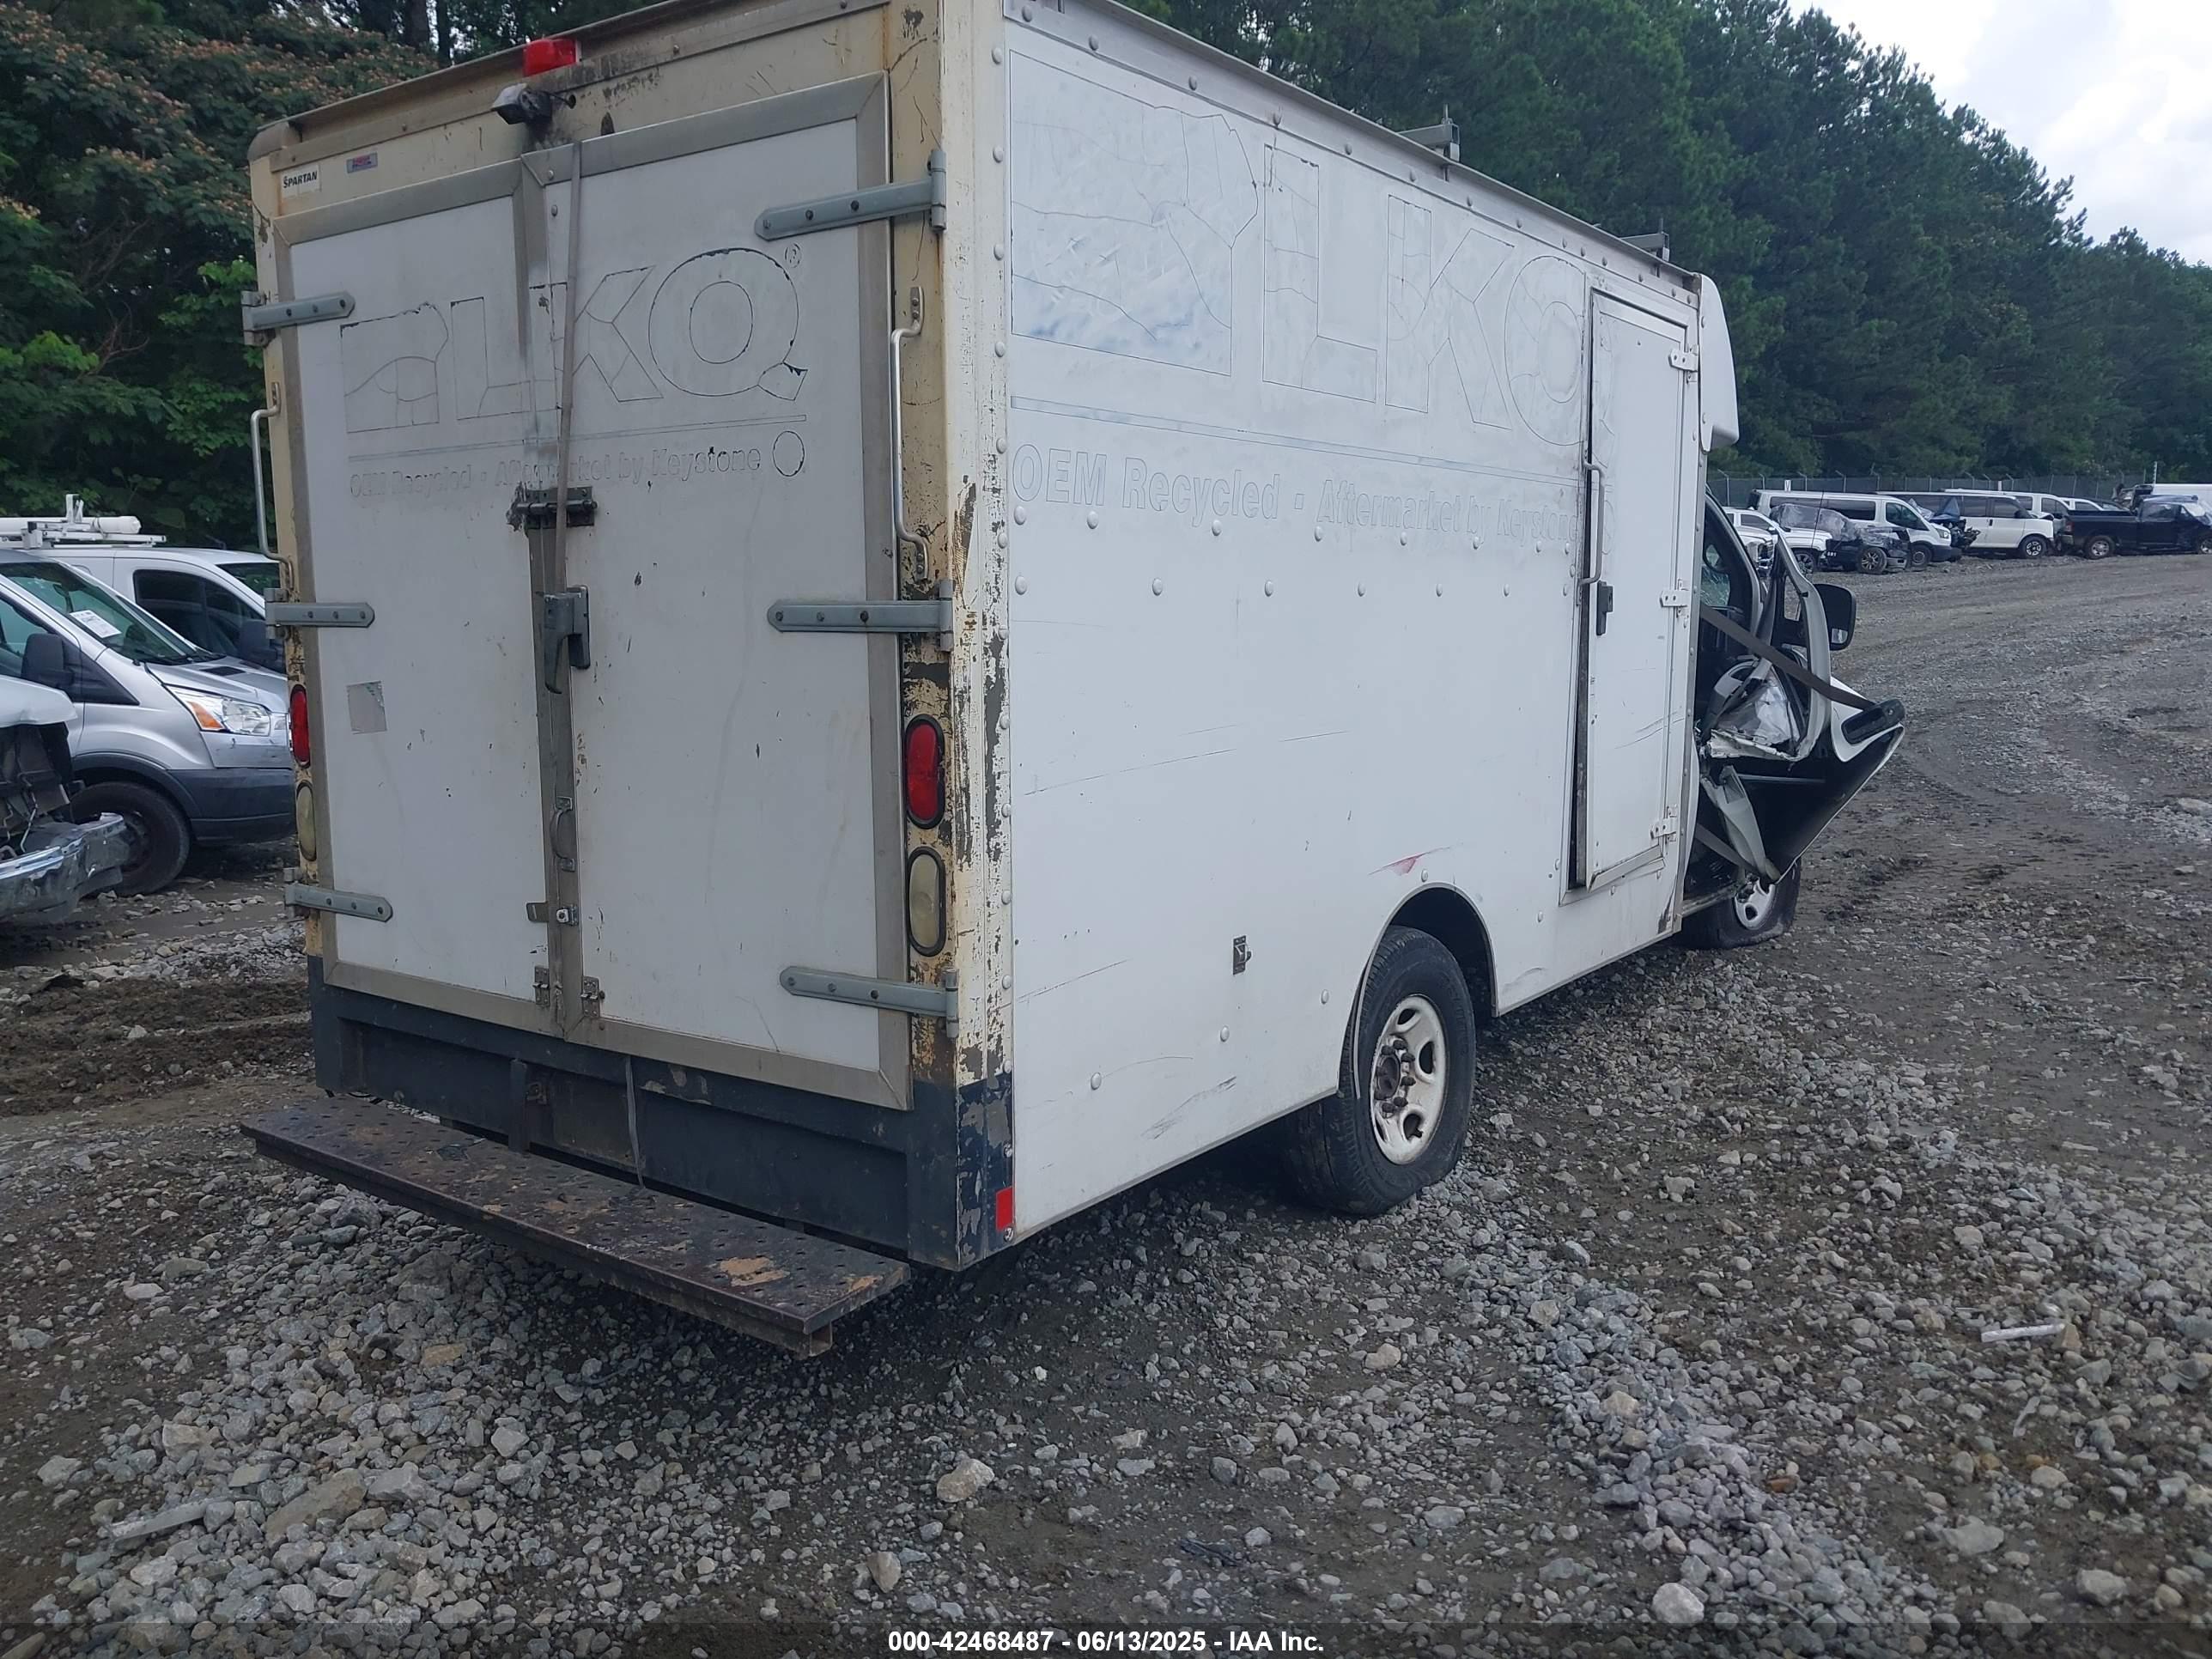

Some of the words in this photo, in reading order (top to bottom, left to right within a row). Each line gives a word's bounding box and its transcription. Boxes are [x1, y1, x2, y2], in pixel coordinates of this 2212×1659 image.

[283, 171, 318, 188] SPARTAN
[652, 447, 761, 481] Keystone
[1012, 444, 1107, 507] OEM
[1122, 457, 1280, 528] Recycled
[1316, 479, 1461, 532] Aftermarket
